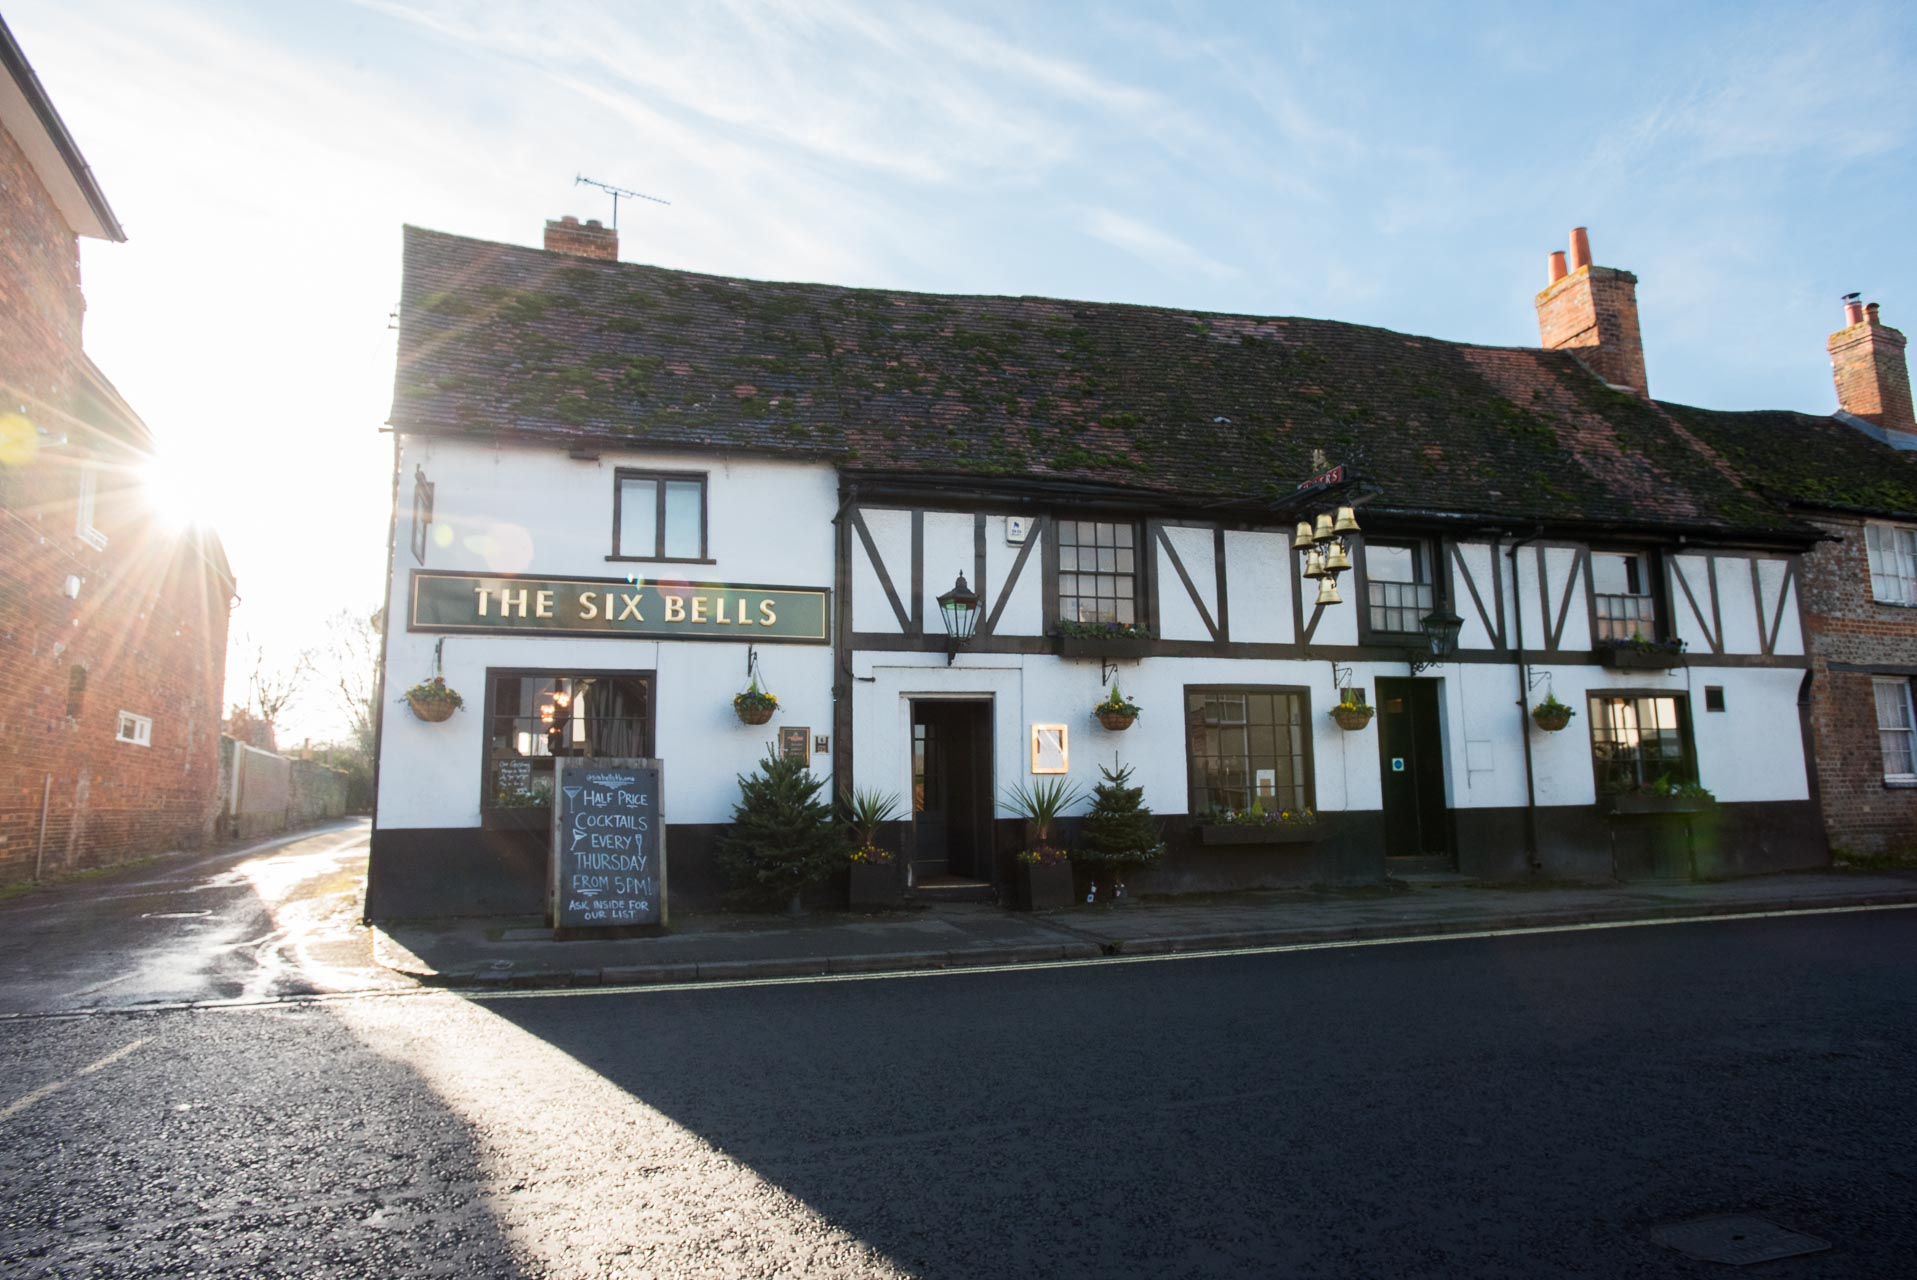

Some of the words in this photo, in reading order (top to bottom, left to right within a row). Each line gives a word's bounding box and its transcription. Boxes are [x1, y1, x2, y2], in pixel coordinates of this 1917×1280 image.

[474, 587, 554, 619] THE
[579, 591, 644, 622] SIX
[665, 595, 777, 627] BELLS
[583, 790, 614, 806] HALF
[617, 790, 648, 806] PRICE
[575, 812, 648, 831] COCKTAILS
[591, 834, 632, 850] EVERY
[573, 852, 647, 872] THURSDAY
[573, 874, 609, 891] FROM
[614, 876, 652, 896] 5PM!
[569, 900, 590, 911] ASK
[593, 900, 625, 910] INSIDE
[628, 900, 650, 911] FOR
[584, 911, 607, 920] OUR
[612, 910, 635, 919] LIST
